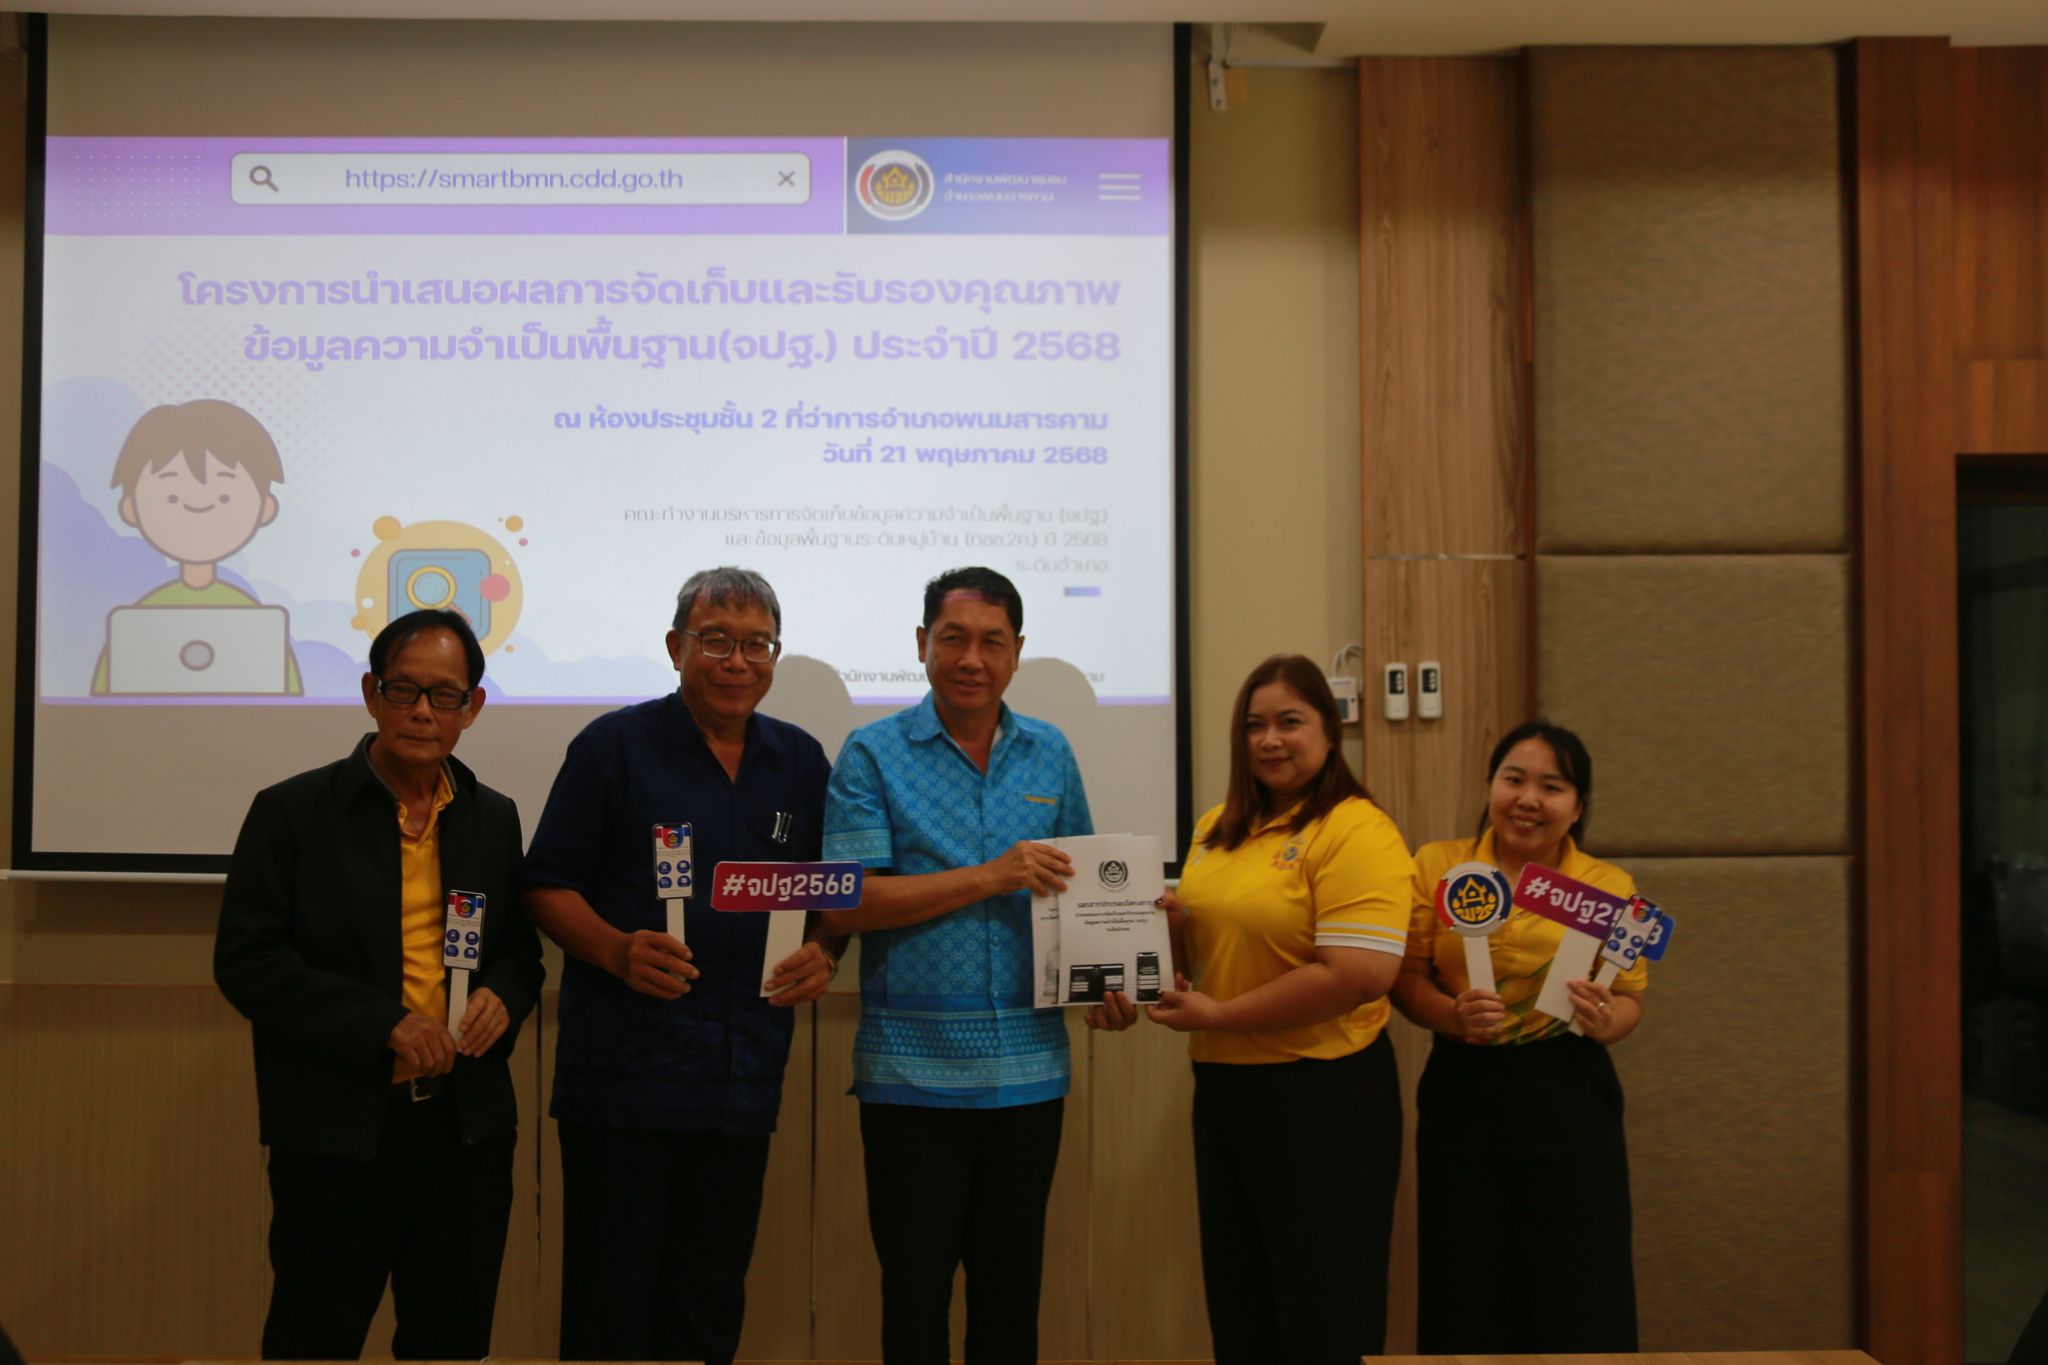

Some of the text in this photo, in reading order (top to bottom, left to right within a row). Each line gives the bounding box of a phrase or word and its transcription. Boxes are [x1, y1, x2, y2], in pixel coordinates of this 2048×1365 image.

[345, 168, 684, 193] https://smartbmn.cdd.go.th
[177, 267, 1121, 314] โครงการนำเสนอผลการจัดเก็บและรับรองคุณภาพ
[243, 315, 1121, 372] ข้อมูลความจำเป็นพื้นฐาน(จปฐ.) ประจำปี 2568
[554, 400, 1109, 435] ณ ห้องประชุมชั้น 2 ที่ว่าการอำเภอพนมสารคาม
[822, 437, 1109, 468] วันที่ 21 พฤษภาคม 2568
[1063, 531, 1109, 547] 2568
[722, 872, 856, 902] #จปฐ2568
